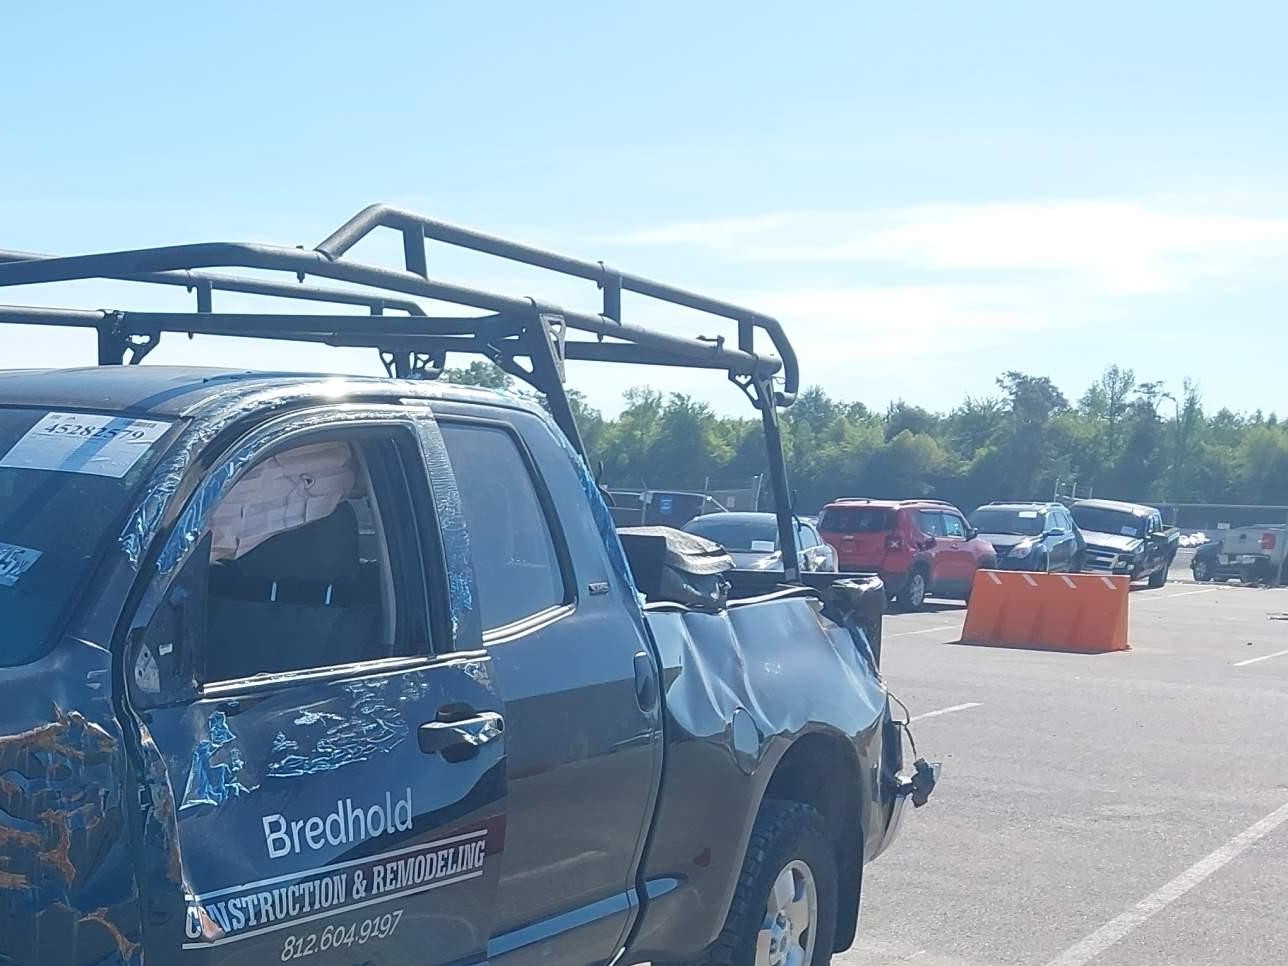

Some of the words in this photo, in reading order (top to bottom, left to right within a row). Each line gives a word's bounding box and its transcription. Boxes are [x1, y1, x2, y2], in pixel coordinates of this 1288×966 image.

[44, 423, 145, 441] 45282579
[262, 788, 413, 859] Bredhold
[185, 873, 347, 939] CNSTRUCTION
[352, 870, 367, 899] &
[371, 839, 487, 894] REMODELING
[280, 910, 404, 962] 812.604.9197
